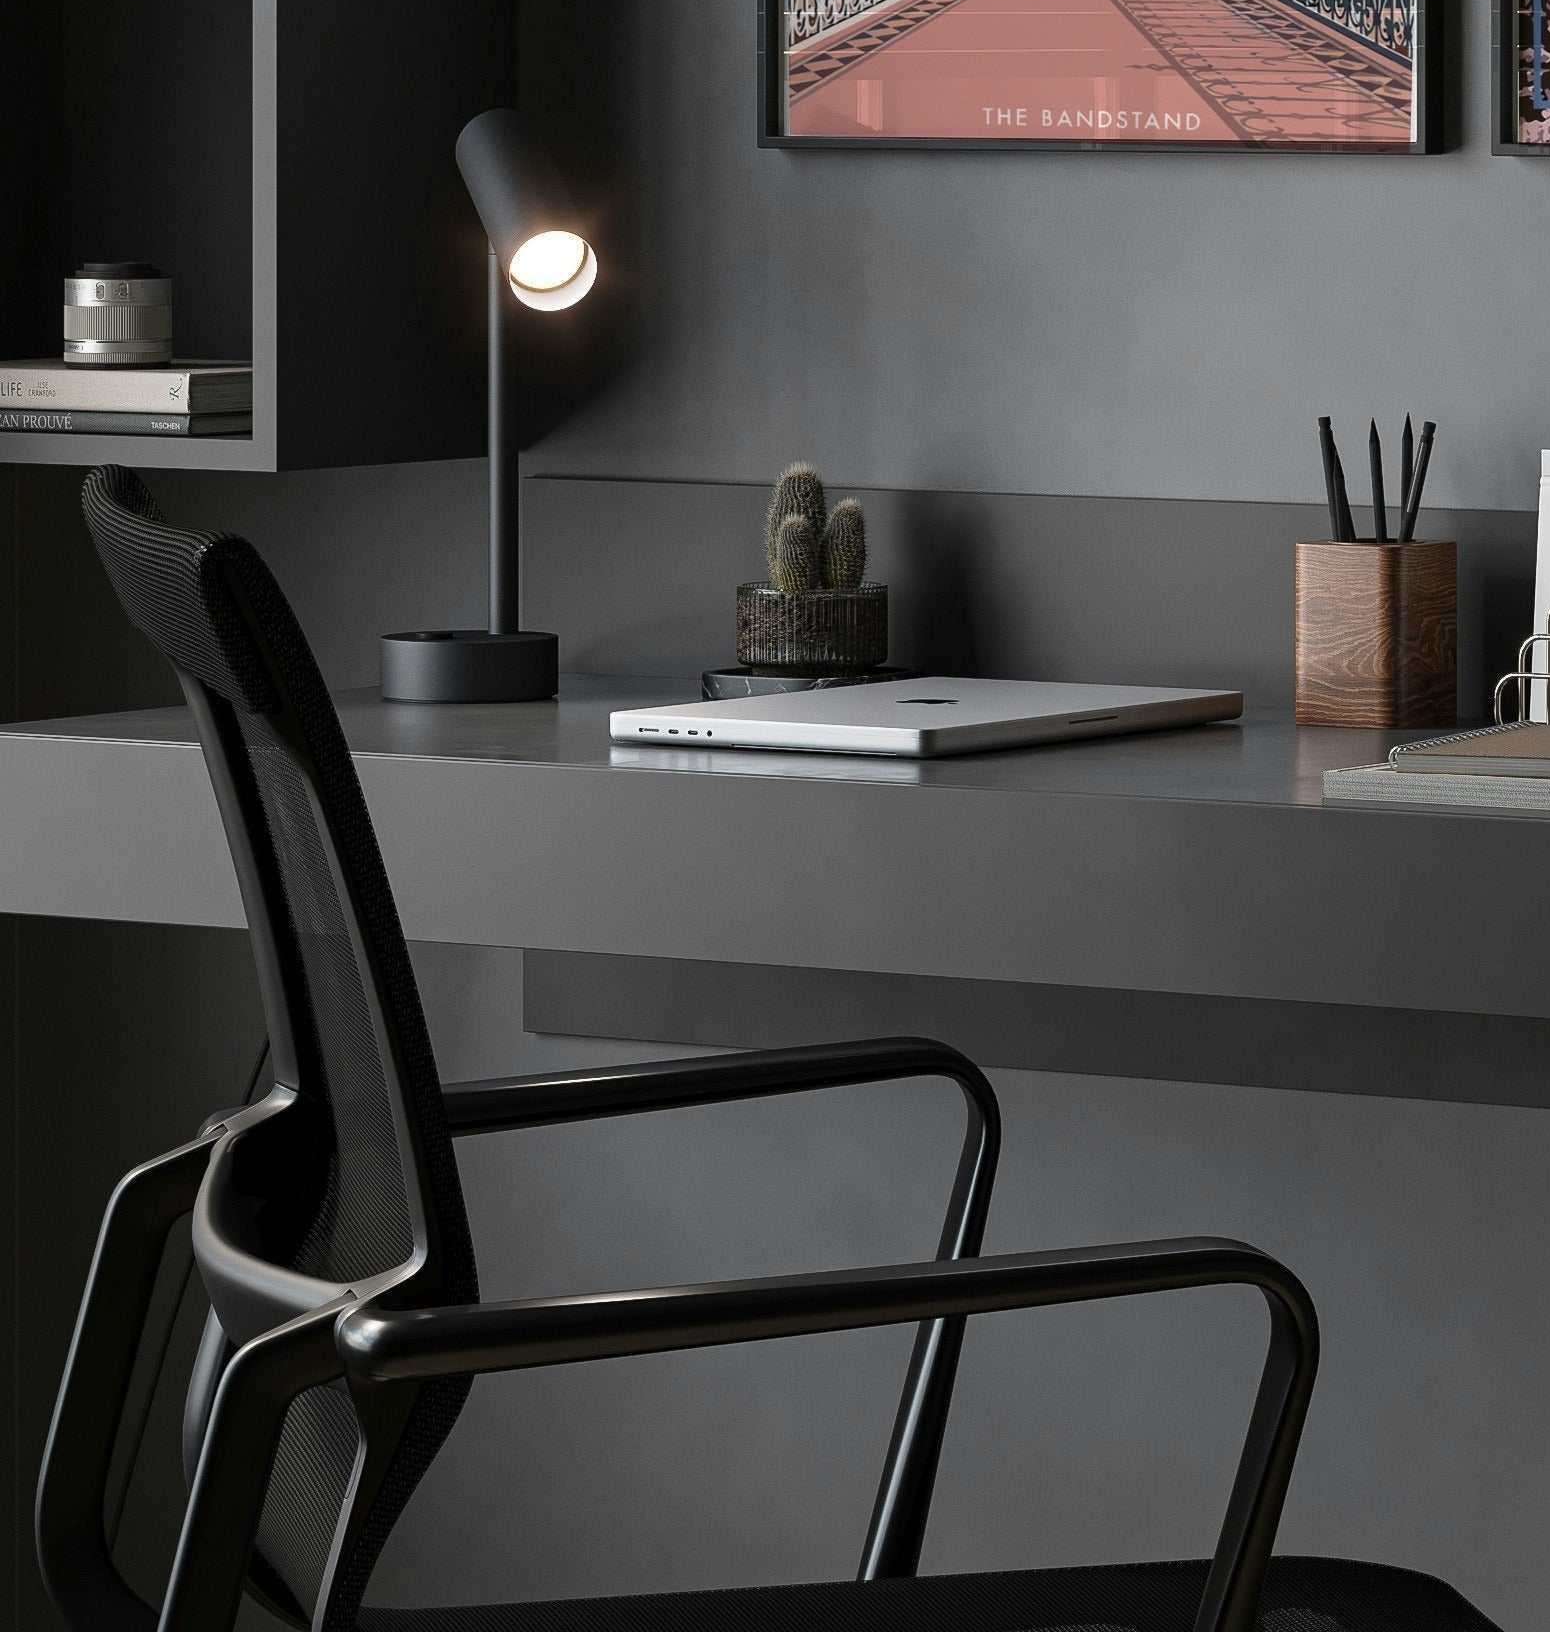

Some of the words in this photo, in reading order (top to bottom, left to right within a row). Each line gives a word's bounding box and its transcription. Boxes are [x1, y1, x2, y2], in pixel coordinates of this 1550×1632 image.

[982, 107, 1028, 127] THE
[1041, 108, 1201, 131] BANDSTAND
[0, 381, 23, 397] LIFE
[37, 381, 49, 389] ILSE
[28, 389, 57, 398] CRAWFORD
[22, 413, 73, 430] PROUVÉ
[150, 420, 181, 431] TASCHEN
